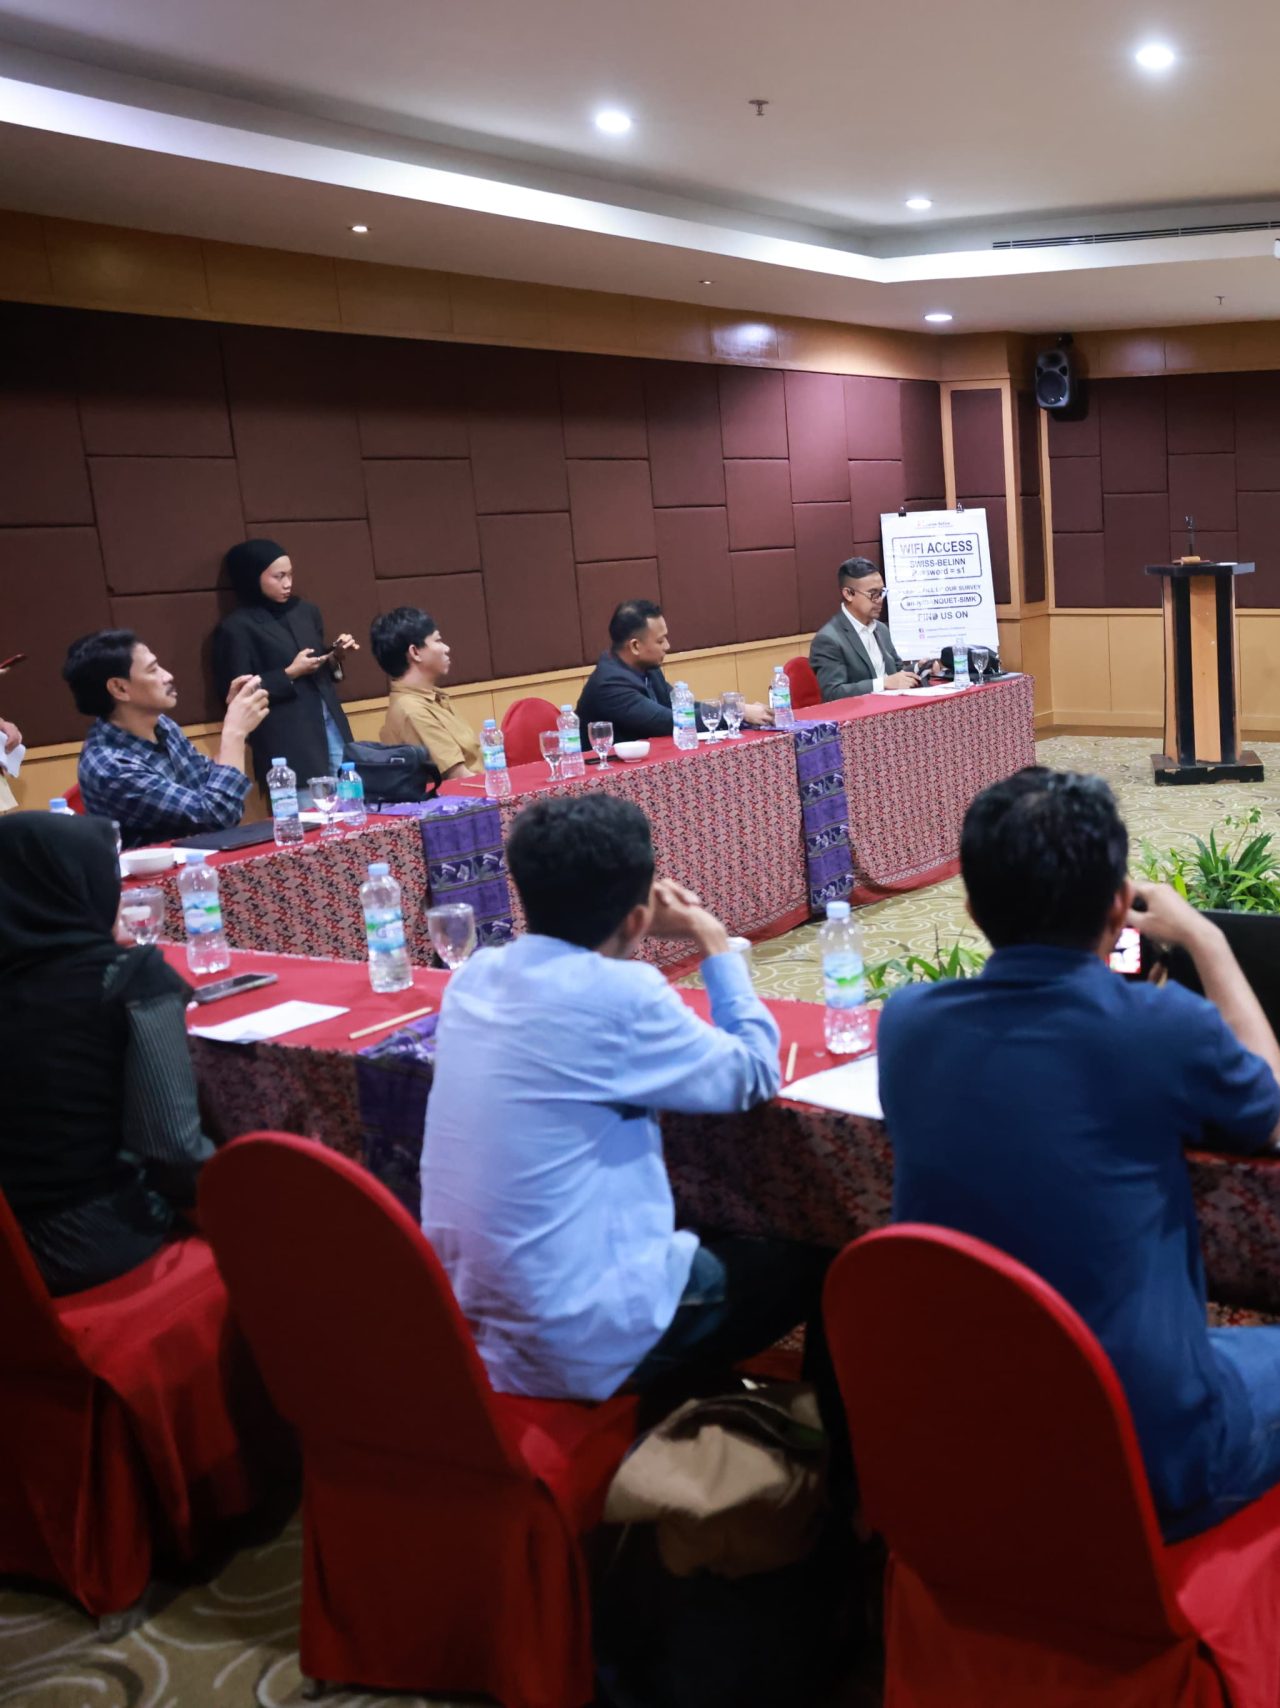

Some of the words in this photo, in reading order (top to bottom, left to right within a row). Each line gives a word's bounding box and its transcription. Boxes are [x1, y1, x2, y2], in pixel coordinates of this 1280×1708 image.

[900, 543, 924, 555] WIFI
[927, 540, 973, 554] ACCESS
[940, 611, 953, 620] US
[955, 611, 969, 619] ON
